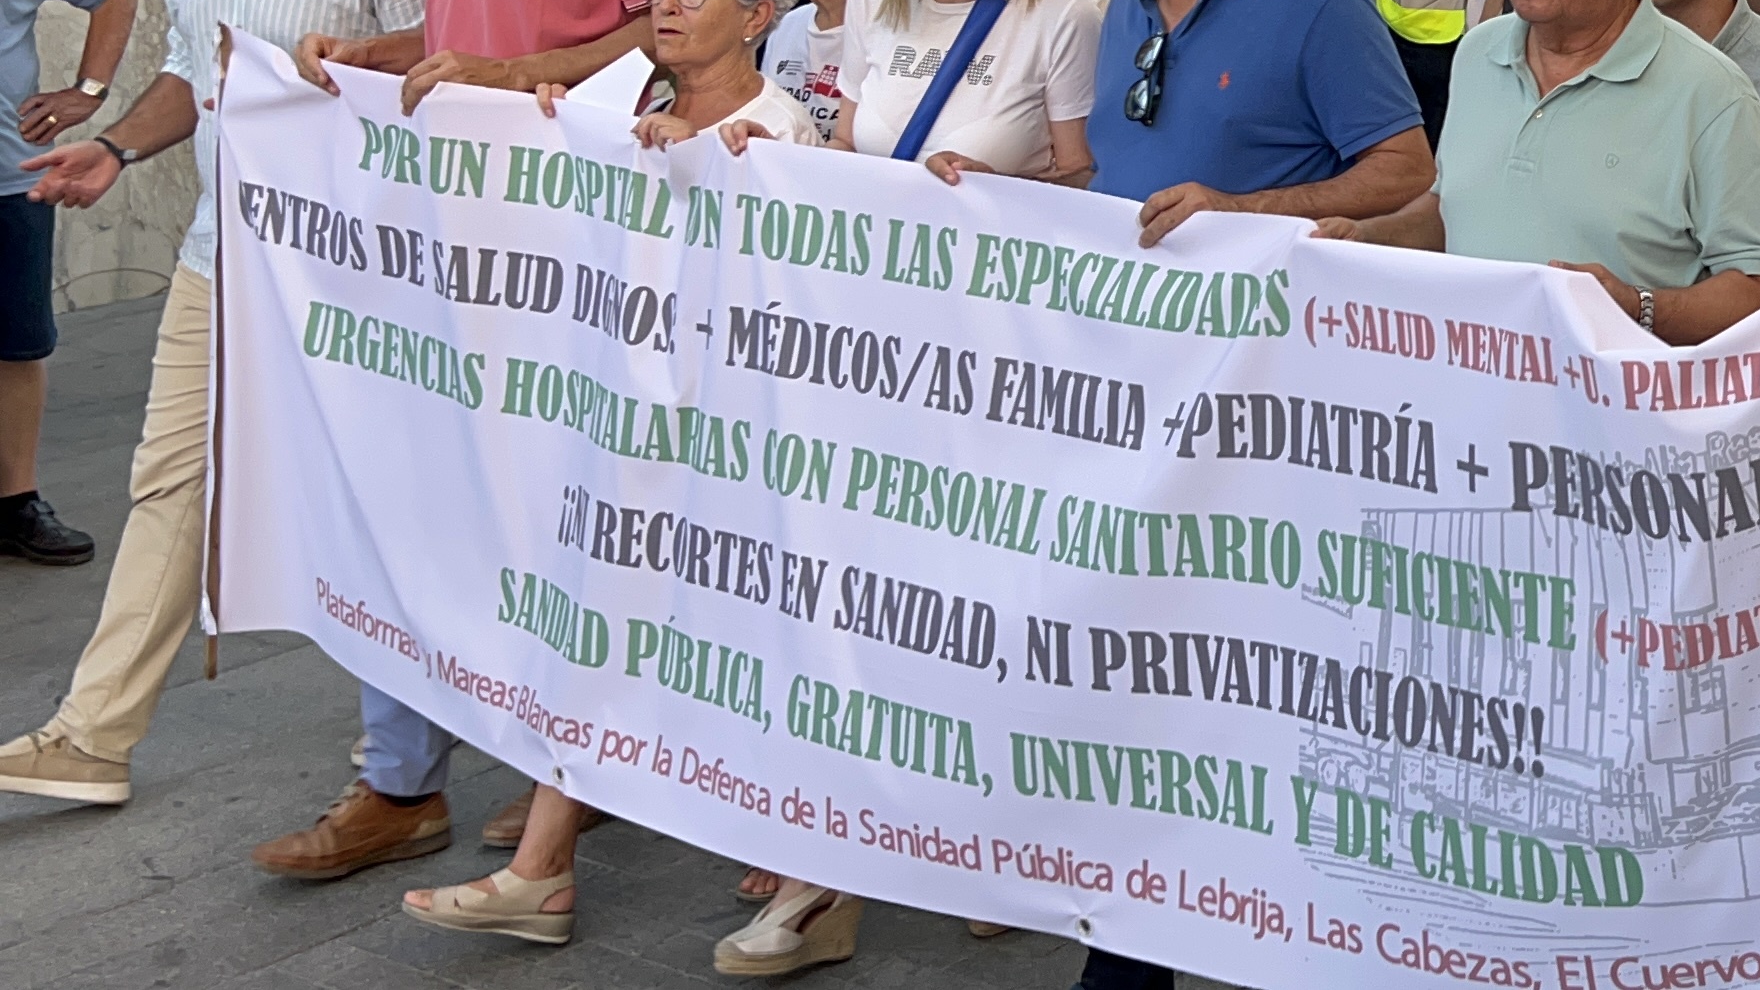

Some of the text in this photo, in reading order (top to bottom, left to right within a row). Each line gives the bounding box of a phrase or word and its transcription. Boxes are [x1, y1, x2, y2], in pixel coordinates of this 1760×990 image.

[357, 115, 423, 186] POR
[429, 135, 491, 199] UN
[503, 144, 675, 240] HOSPITAL
[736, 193, 873, 277] TODAS
[882, 217, 958, 292] LAS
[1304, 295, 1436, 362] (+SALUD
[1445, 318, 1558, 387] MENTAL
[1562, 353, 1611, 408] +U.
[376, 224, 425, 287] DE
[432, 239, 564, 314] SALUD
[725, 300, 977, 416] MÉDICOS/AS
[986, 356, 1146, 451] FAMILIA
[1162, 391, 1438, 494] +PEDIATRÍA
[1456, 443, 1490, 494] +
[302, 300, 487, 411] URGENCIAS
[500, 356, 752, 482] HOSPITALARIAS
[762, 427, 838, 505] CON
[843, 444, 1048, 574] PERSONAL
[1048, 492, 1301, 591] SANITARIO
[1317, 527, 1578, 653] SUFICIENTE
[315, 576, 421, 662] Plataformas
[422, 646, 432, 679] y
[437, 649, 518, 712] Mareas
[516, 684, 594, 749] Blancas
[597, 726, 648, 766] por
[651, 735, 671, 777] la
[679, 747, 771, 816] Defensa
[780, 786, 818, 832] de
[824, 797, 849, 840] la
[859, 808, 982, 872] Sanidad
[992, 838, 1115, 894] Pública
[1124, 858, 1167, 907] de
[1178, 866, 1295, 945] Lebrija,
[1306, 902, 1365, 954] Las
[1375, 923, 1544, 990] Cabezas,
[1555, 954, 1598, 990] El
[497, 566, 1645, 908] SANIDAD PÚBLICA, GRATUITA, UNIVERSAL Y DE CALIDAD
[590, 498, 774, 606] RECORTES
[779, 549, 829, 623] EN
[833, 564, 1009, 685] SANIDAD,
[1025, 614, 1073, 688] NI
[1088, 627, 1546, 779] PRIVATIZACIONES!!
